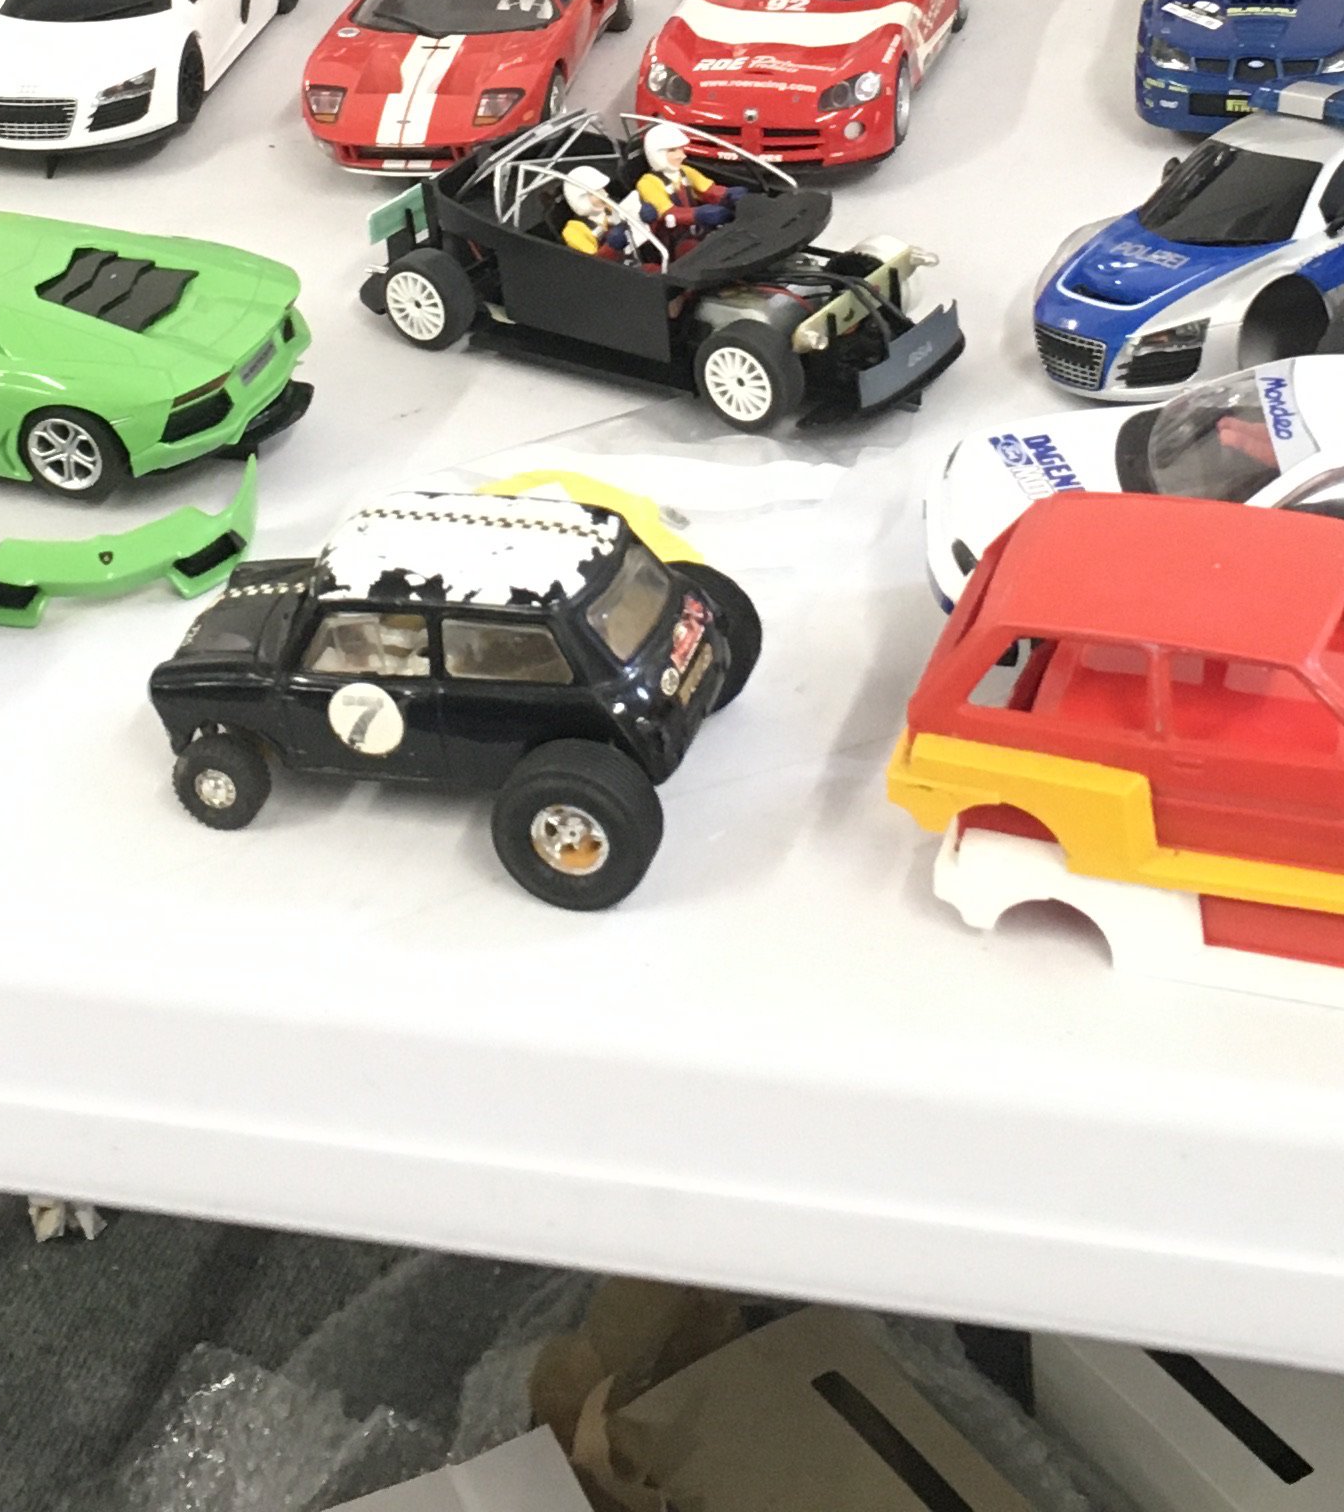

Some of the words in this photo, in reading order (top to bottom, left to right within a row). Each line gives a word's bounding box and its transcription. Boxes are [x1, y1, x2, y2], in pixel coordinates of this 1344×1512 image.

[692, 56, 750, 71] ROE
[1110, 240, 1190, 270] POLIZEI
[1258, 375, 1293, 441] Mondeo
[1022, 433, 1086, 493] DAGEN
[342, 694, 384, 746] 7
